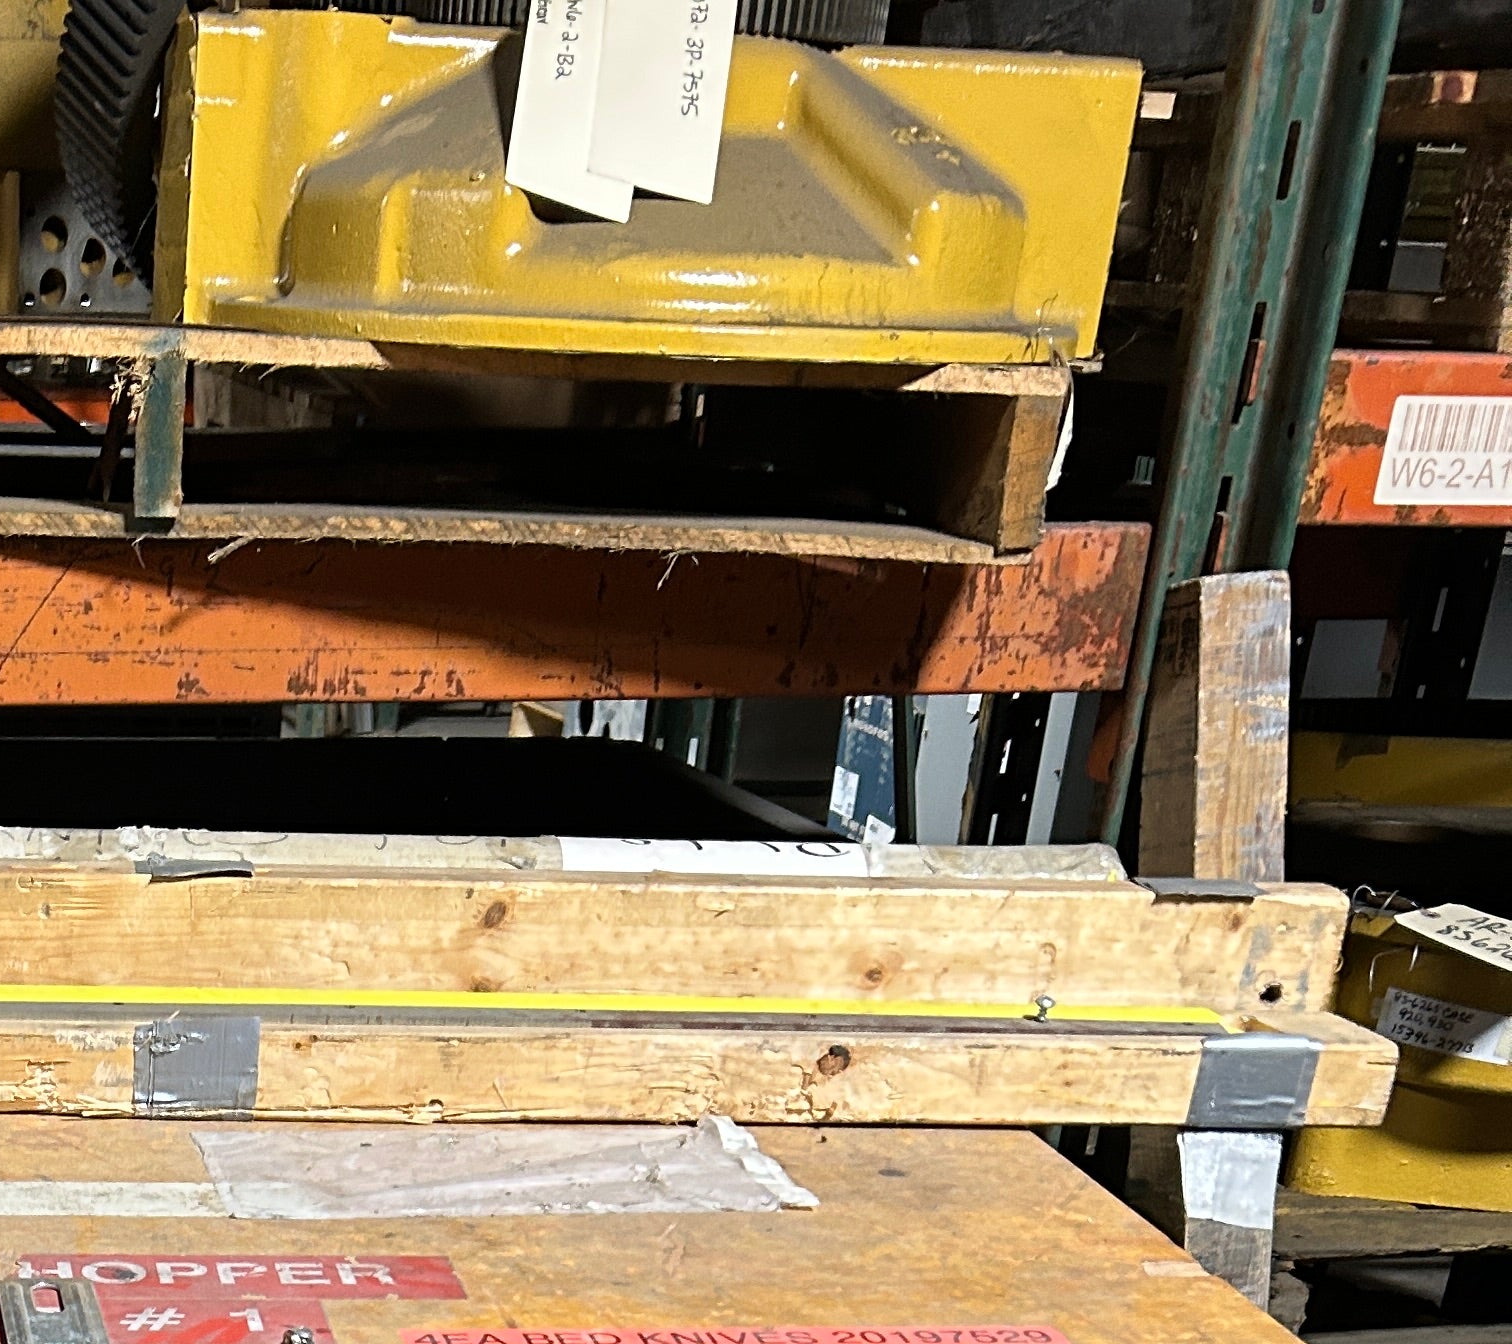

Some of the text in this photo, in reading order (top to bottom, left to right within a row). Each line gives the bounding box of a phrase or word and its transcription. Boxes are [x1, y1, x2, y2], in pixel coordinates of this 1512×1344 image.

[1456, 916, 1512, 942] AR-
[17, 1259, 396, 1285] HOPPER
[118, 1306, 186, 1332] #
[228, 1308, 265, 1332] 1
[832, 1329, 1053, 1344] 20197529
